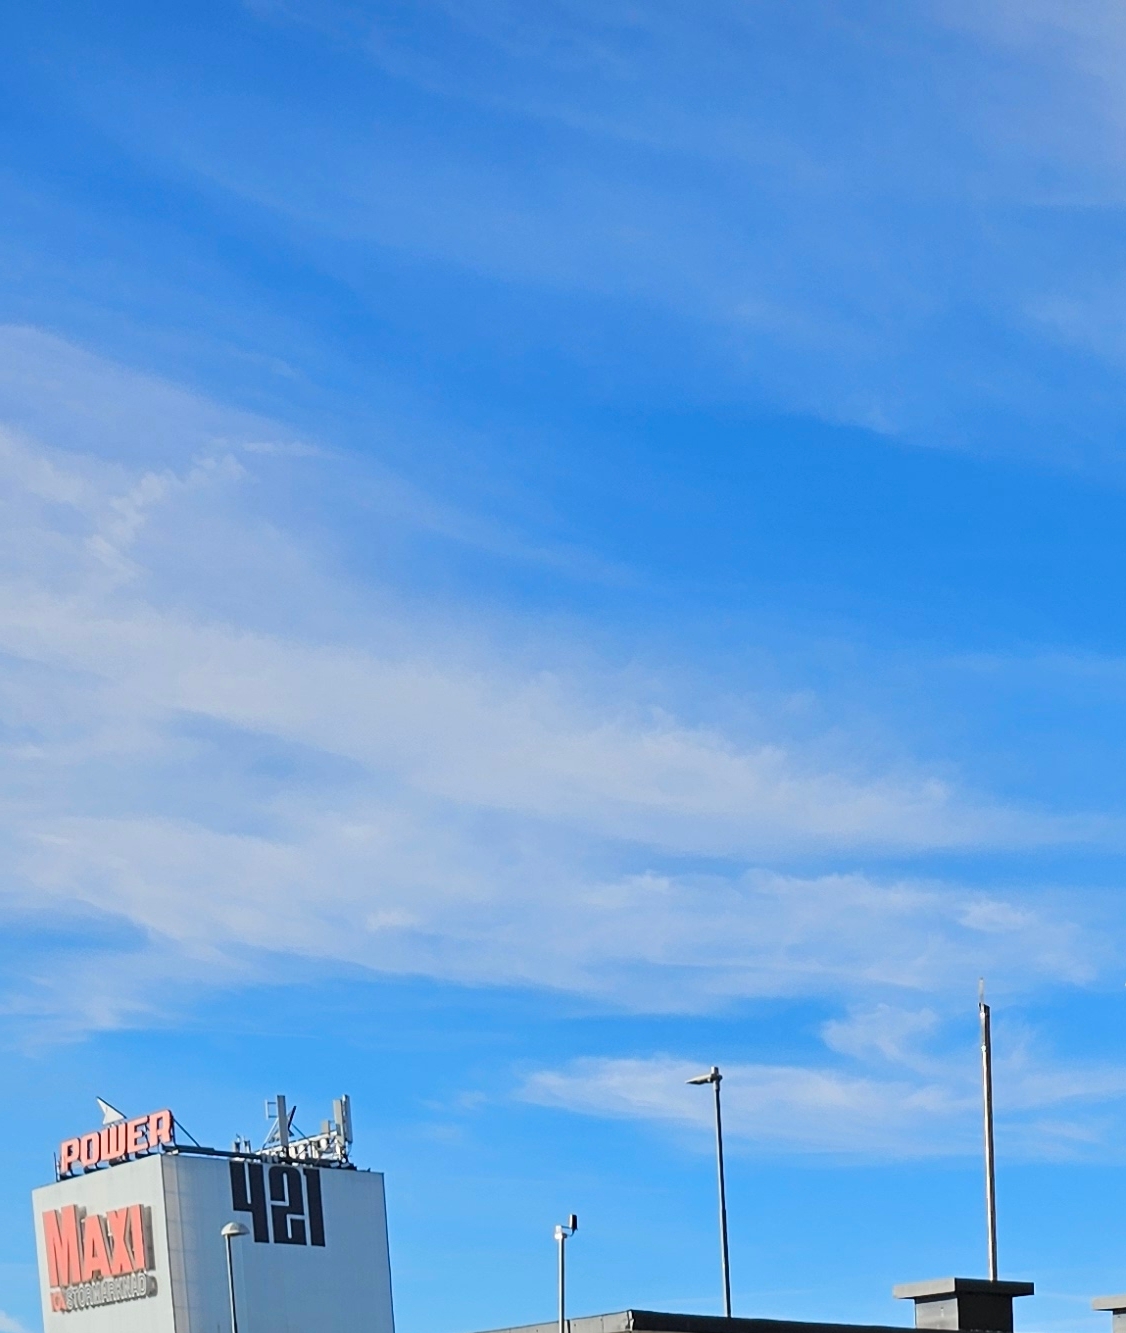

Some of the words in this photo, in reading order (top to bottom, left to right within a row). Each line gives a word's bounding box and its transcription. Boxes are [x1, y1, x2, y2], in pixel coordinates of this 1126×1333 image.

[60, 1109, 174, 1173] POWER
[229, 1162, 326, 1247] 421
[66, 1273, 147, 1310] STORMARKNAD
